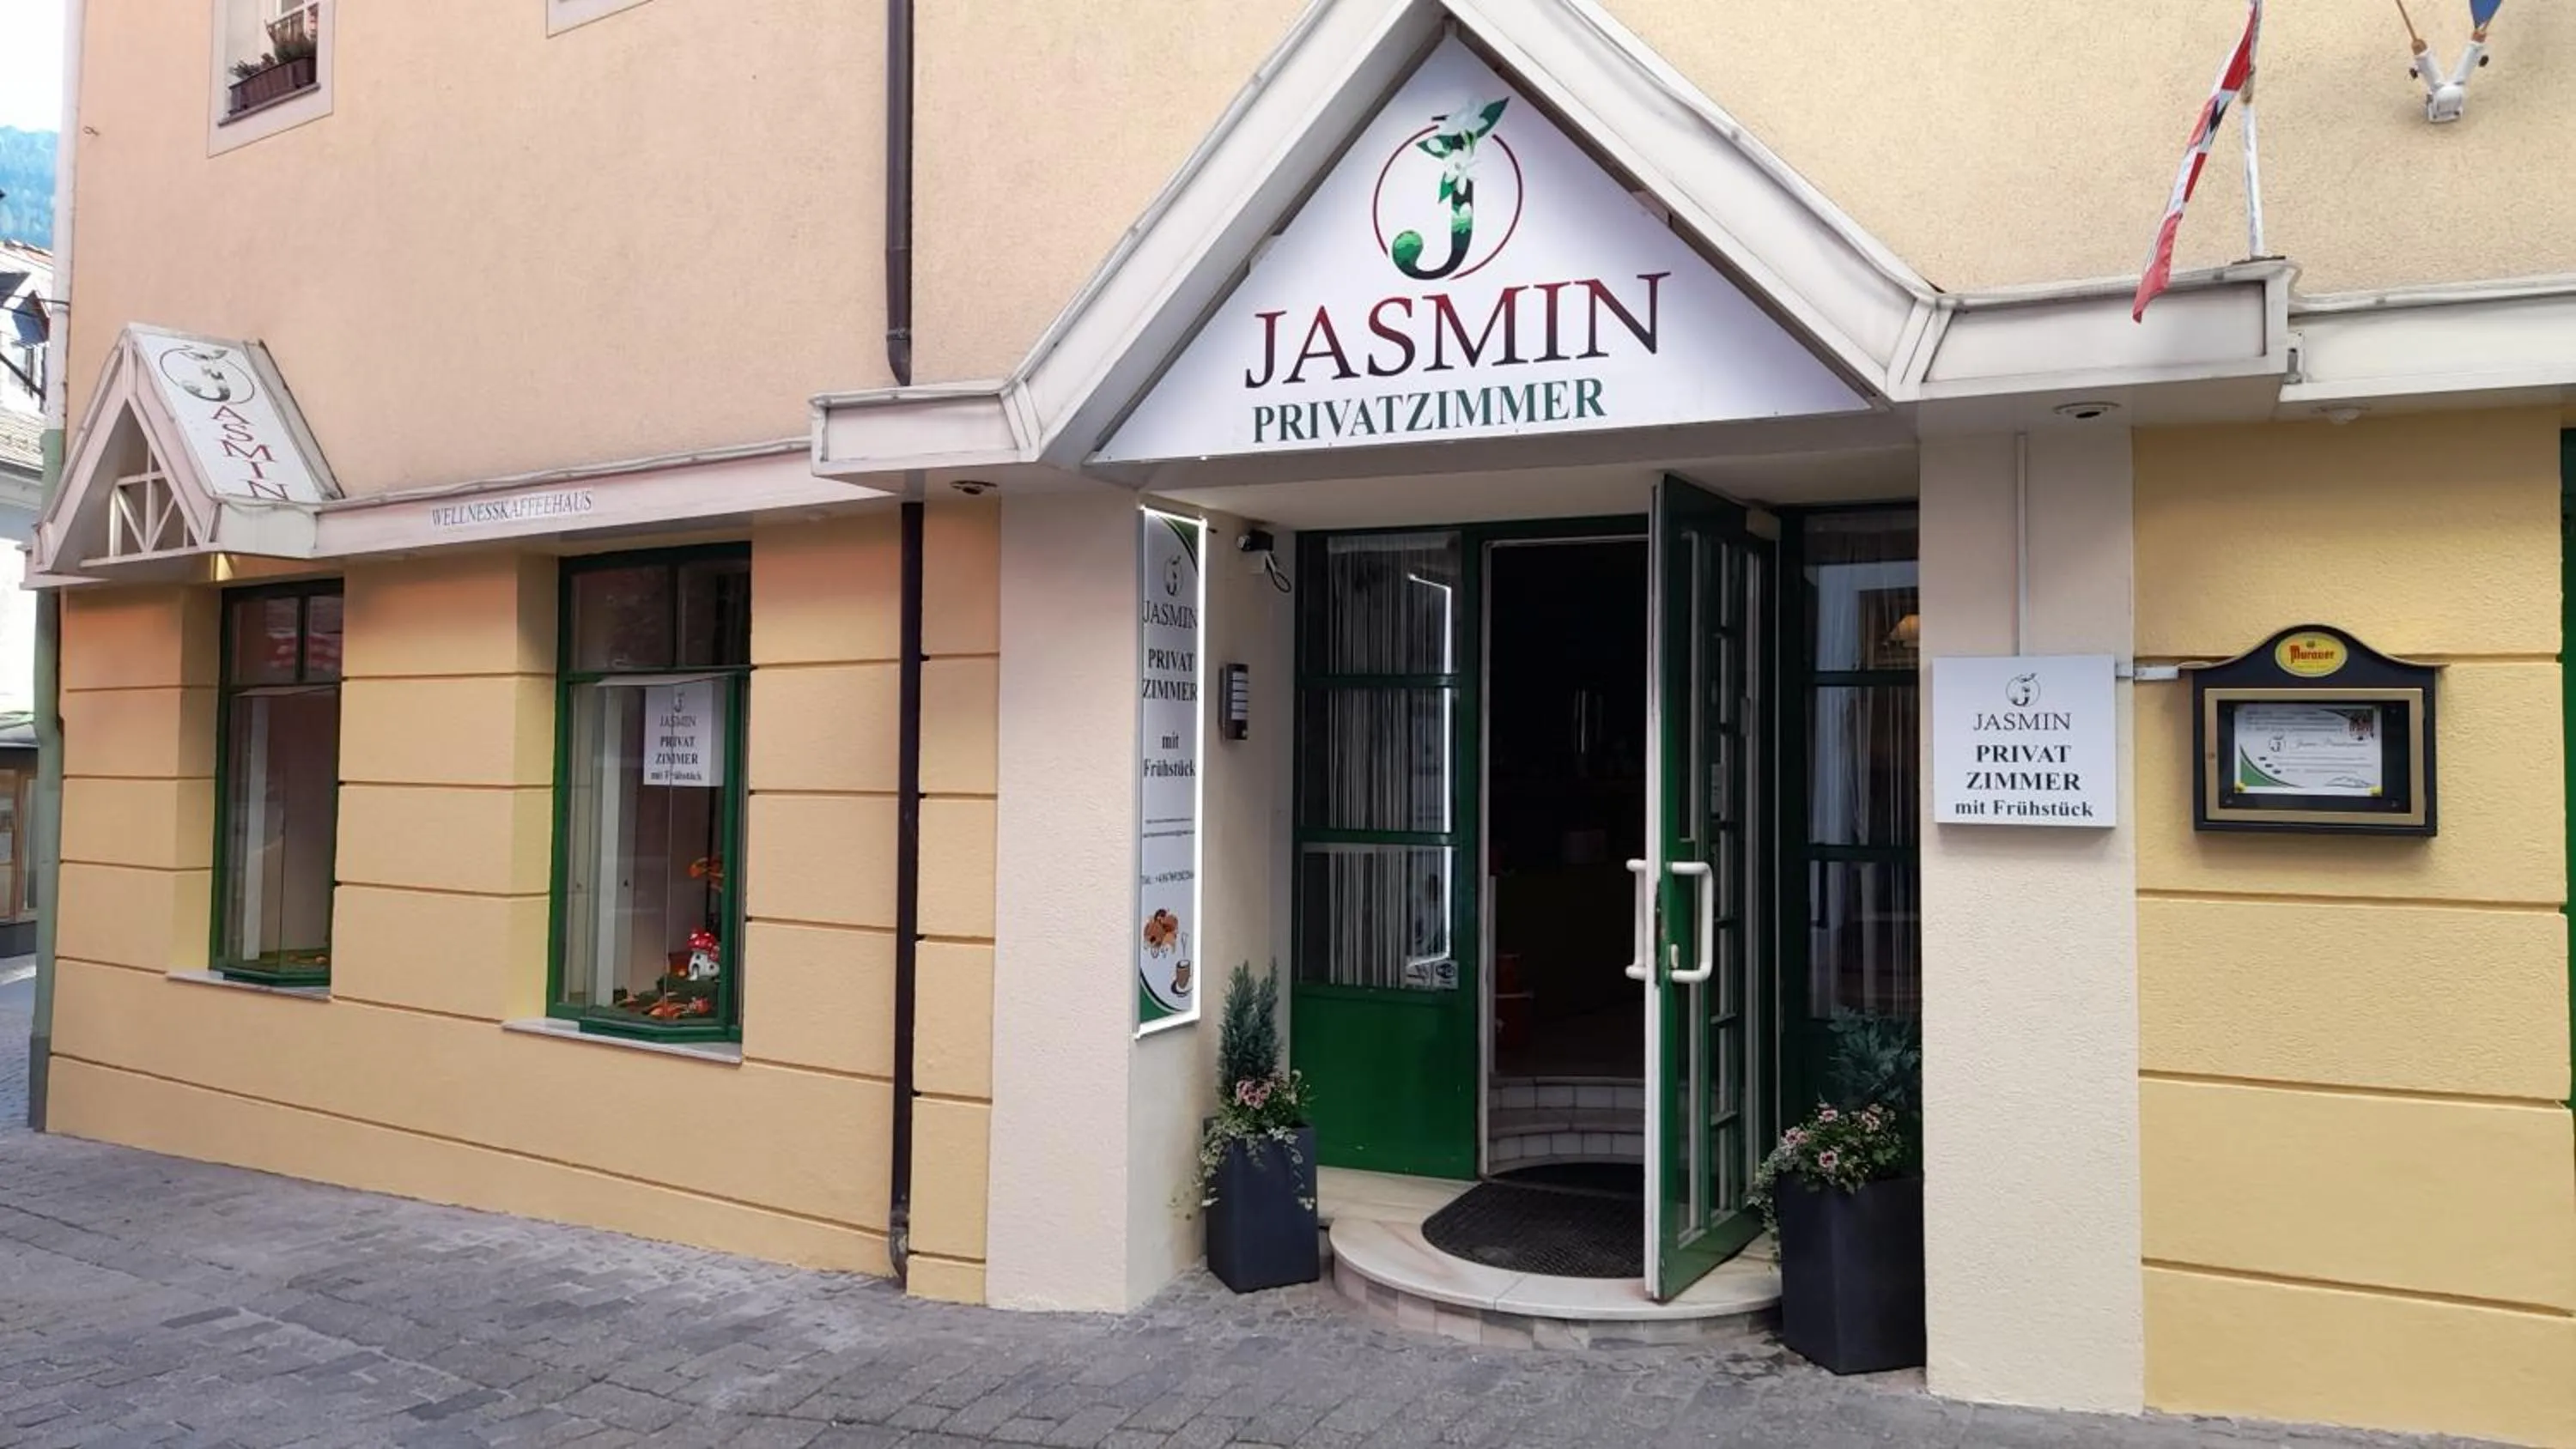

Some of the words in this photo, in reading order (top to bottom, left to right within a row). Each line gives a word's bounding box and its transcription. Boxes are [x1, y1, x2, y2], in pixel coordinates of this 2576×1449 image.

[1245, 271, 1672, 389] JASMIN
[1253, 377, 1607, 444] PRIVATZIMMER
[432, 490, 592, 527] WELLNESSKAFFEEHAUS
[1142, 600, 1198, 629] JASMIN
[1148, 648, 1194, 672] PRIVAT
[1142, 678, 1198, 702] ZIMMER
[1973, 712, 2071, 731] JASMIN
[1162, 732, 1180, 750] mit
[1977, 745, 2072, 763] PRIVAT
[1966, 773, 2081, 791] ZIMMER
[1955, 799, 1985, 815] mit
[1993, 800, 2093, 817] Frühstück
